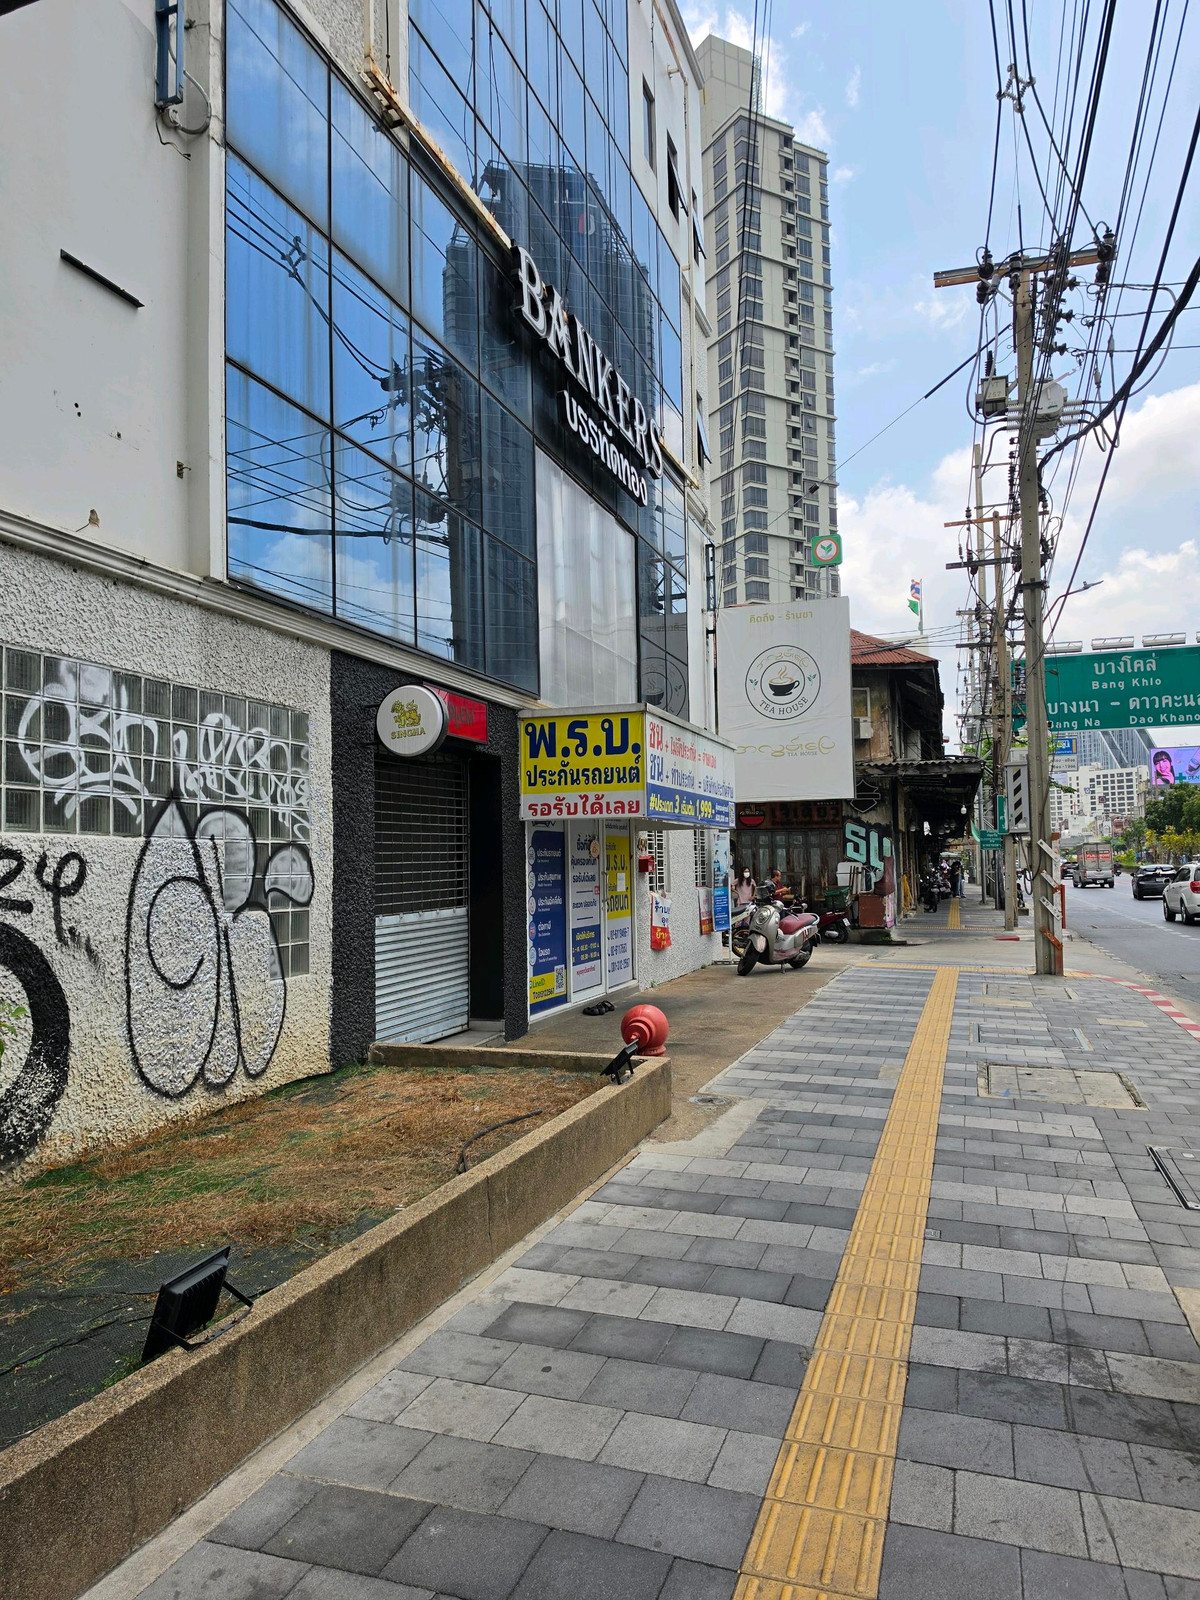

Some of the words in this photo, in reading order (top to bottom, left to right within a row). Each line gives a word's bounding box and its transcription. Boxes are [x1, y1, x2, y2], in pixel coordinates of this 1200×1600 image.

[519, 247, 663, 479] BANKERS
[563, 390, 648, 506] บรรทัดทอง
[749, 612, 775, 623] คิดถึง
[1093, 652, 1157, 675] บางโคล่
[1092, 680, 1125, 690] Bang
[1132, 677, 1162, 687] Khlo
[759, 699, 775, 715] TEA
[778, 696, 809, 715] HOUSE
[1047, 699, 1099, 715] บางนา
[1085, 718, 1100, 727] Na
[1129, 715, 1154, 724] Dao
[390, 727, 426, 740] SINGHA
[524, 717, 642, 759] พ.ร.บ.
[649, 721, 664, 752] ชน
[526, 754, 642, 787] ประกันรถยนต์
[650, 753, 664, 783] ชน
[528, 793, 641, 817] รอรับได้เลย
[675, 794, 680, 814] 3
